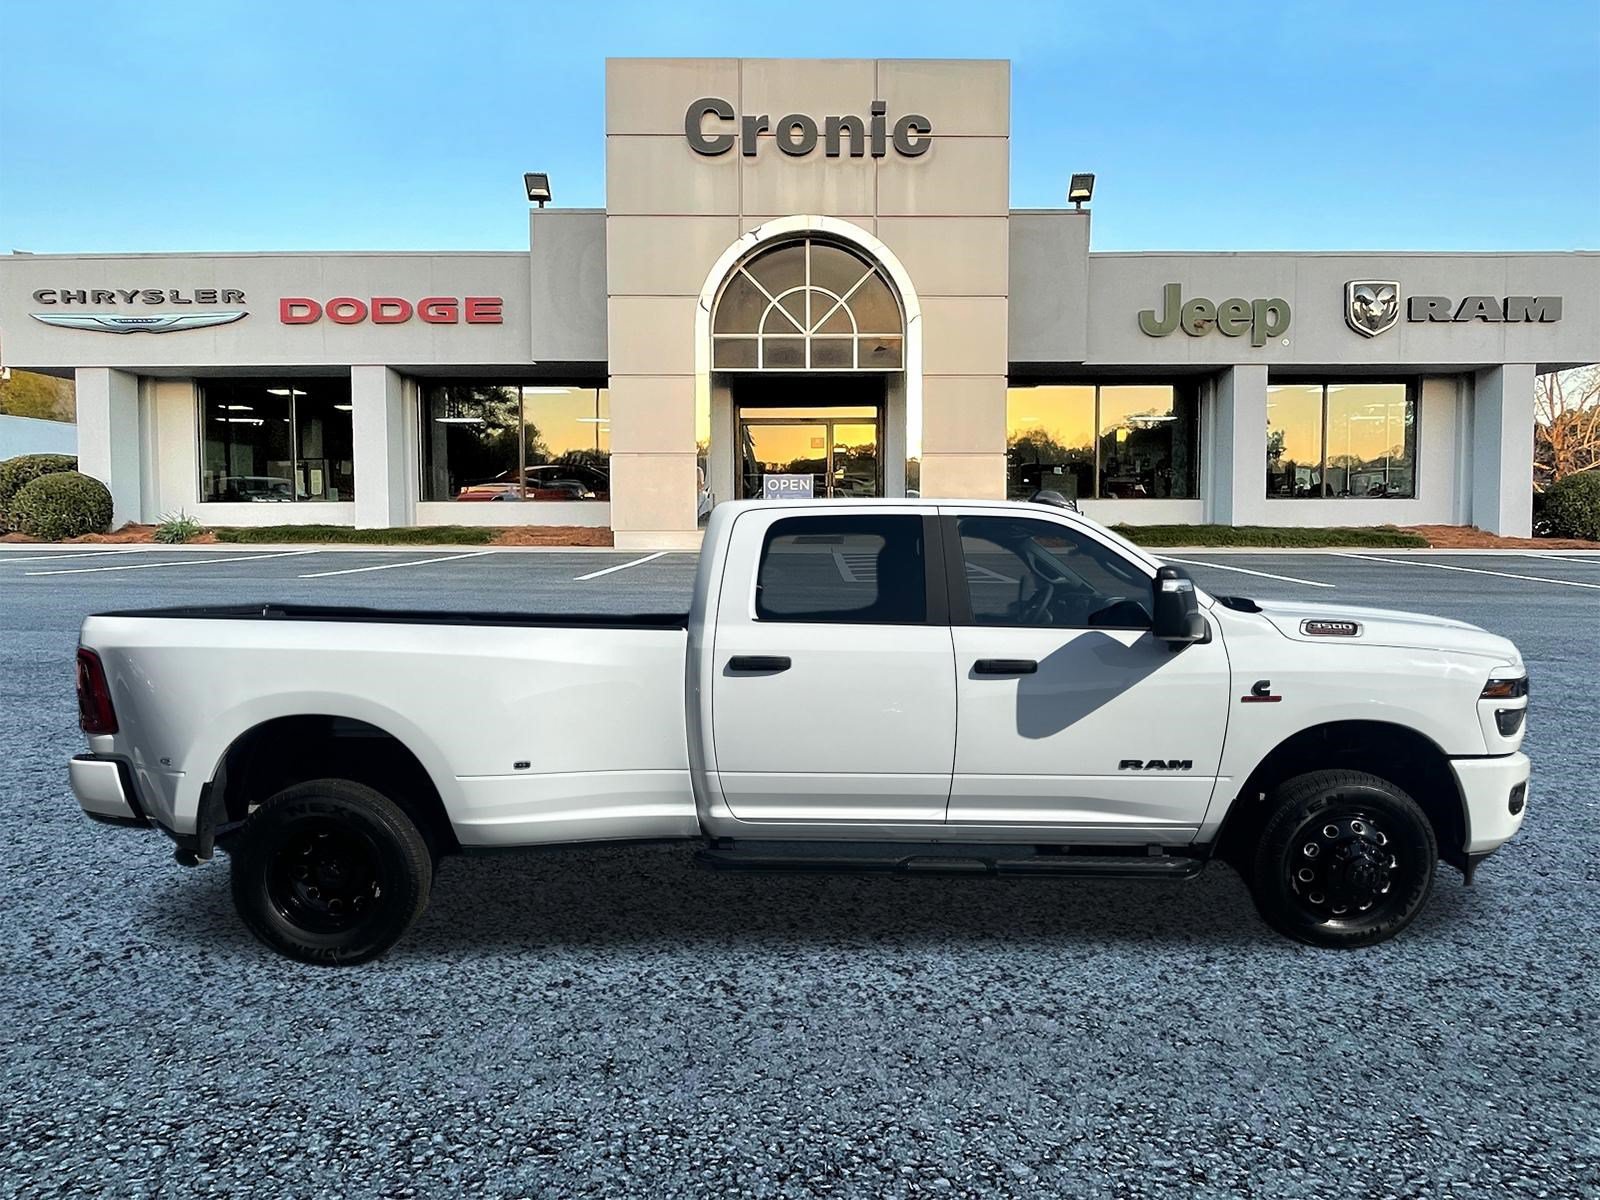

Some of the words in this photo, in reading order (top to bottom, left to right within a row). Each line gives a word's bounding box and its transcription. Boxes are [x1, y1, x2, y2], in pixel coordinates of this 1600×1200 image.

[684, 97, 932, 157] Cronic
[32, 288, 248, 305] CHRYSLER
[1407, 296, 1563, 323] RAM
[279, 297, 504, 325] DODGE
[1138, 283, 1292, 347] Jeep
[767, 479, 810, 490] OPEN
[1118, 759, 1193, 771] RAM
